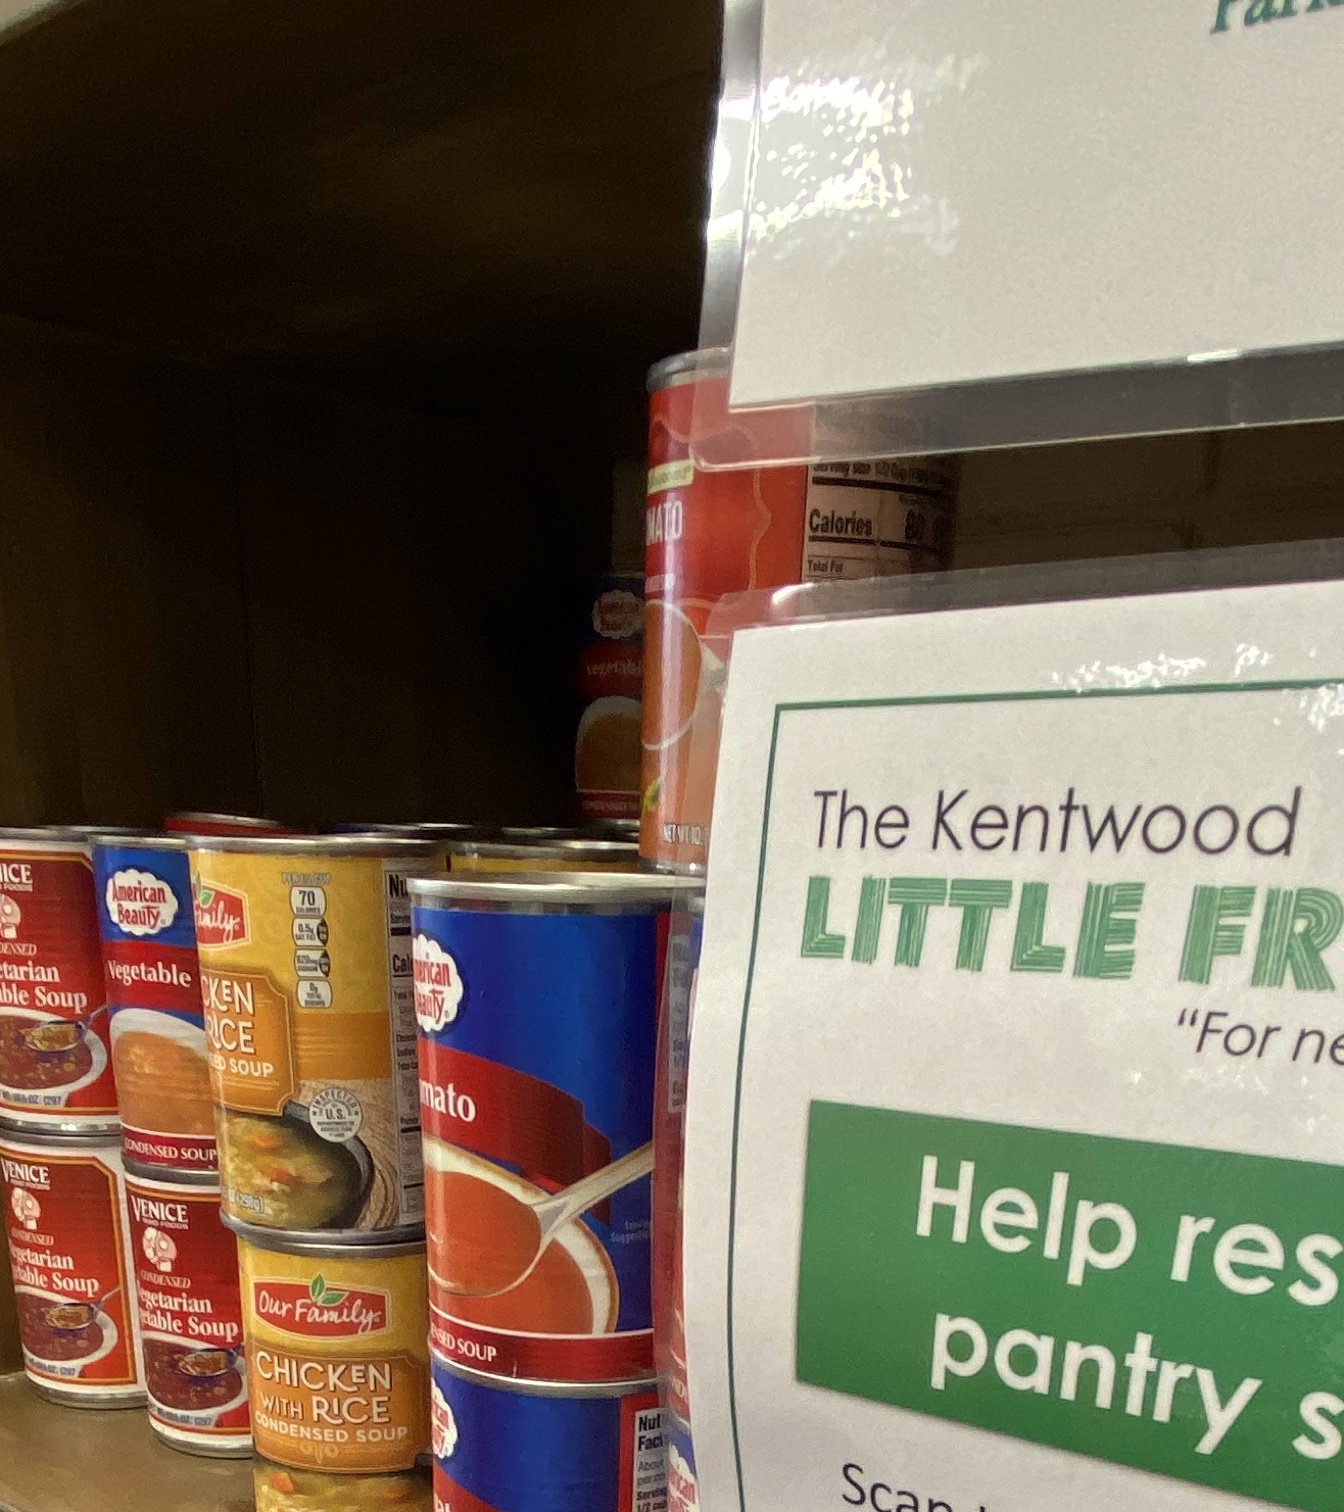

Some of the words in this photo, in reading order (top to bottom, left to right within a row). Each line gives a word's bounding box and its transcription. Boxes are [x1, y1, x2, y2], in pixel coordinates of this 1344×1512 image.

[809, 508, 873, 537] Calories
[813, 788, 911, 850] The
[929, 788, 1302, 862] Kentwood
[112, 880, 167, 904] American
[298, 889, 316, 907] 70
[117, 904, 161, 929] Beauty
[799, 875, 1146, 982] LITTLE
[107, 959, 193, 988] Vegetable
[35, 985, 88, 1015] Soup
[1175, 1007, 1278, 1063] "For
[230, 1057, 274, 1077] SOUP
[419, 1076, 477, 1122] mato
[181, 1145, 218, 1162] SOUP
[0, 1157, 51, 1184] VENICE
[131, 1195, 189, 1223] VENICE
[914, 1152, 1138, 1288] Help
[52, 1271, 100, 1298] Soup
[259, 1289, 292, 1320] Our
[295, 1294, 376, 1334] Family
[188, 1315, 240, 1342] Soup
[458, 1331, 497, 1362] SOUP
[256, 1350, 393, 1392] CHICKEN
[928, 1311, 1260, 1455] pantry
[260, 1391, 304, 1420] WITH
[311, 1395, 390, 1425] RICE
[255, 1410, 349, 1443] CONDENSED
[356, 1426, 408, 1443] SOUP
